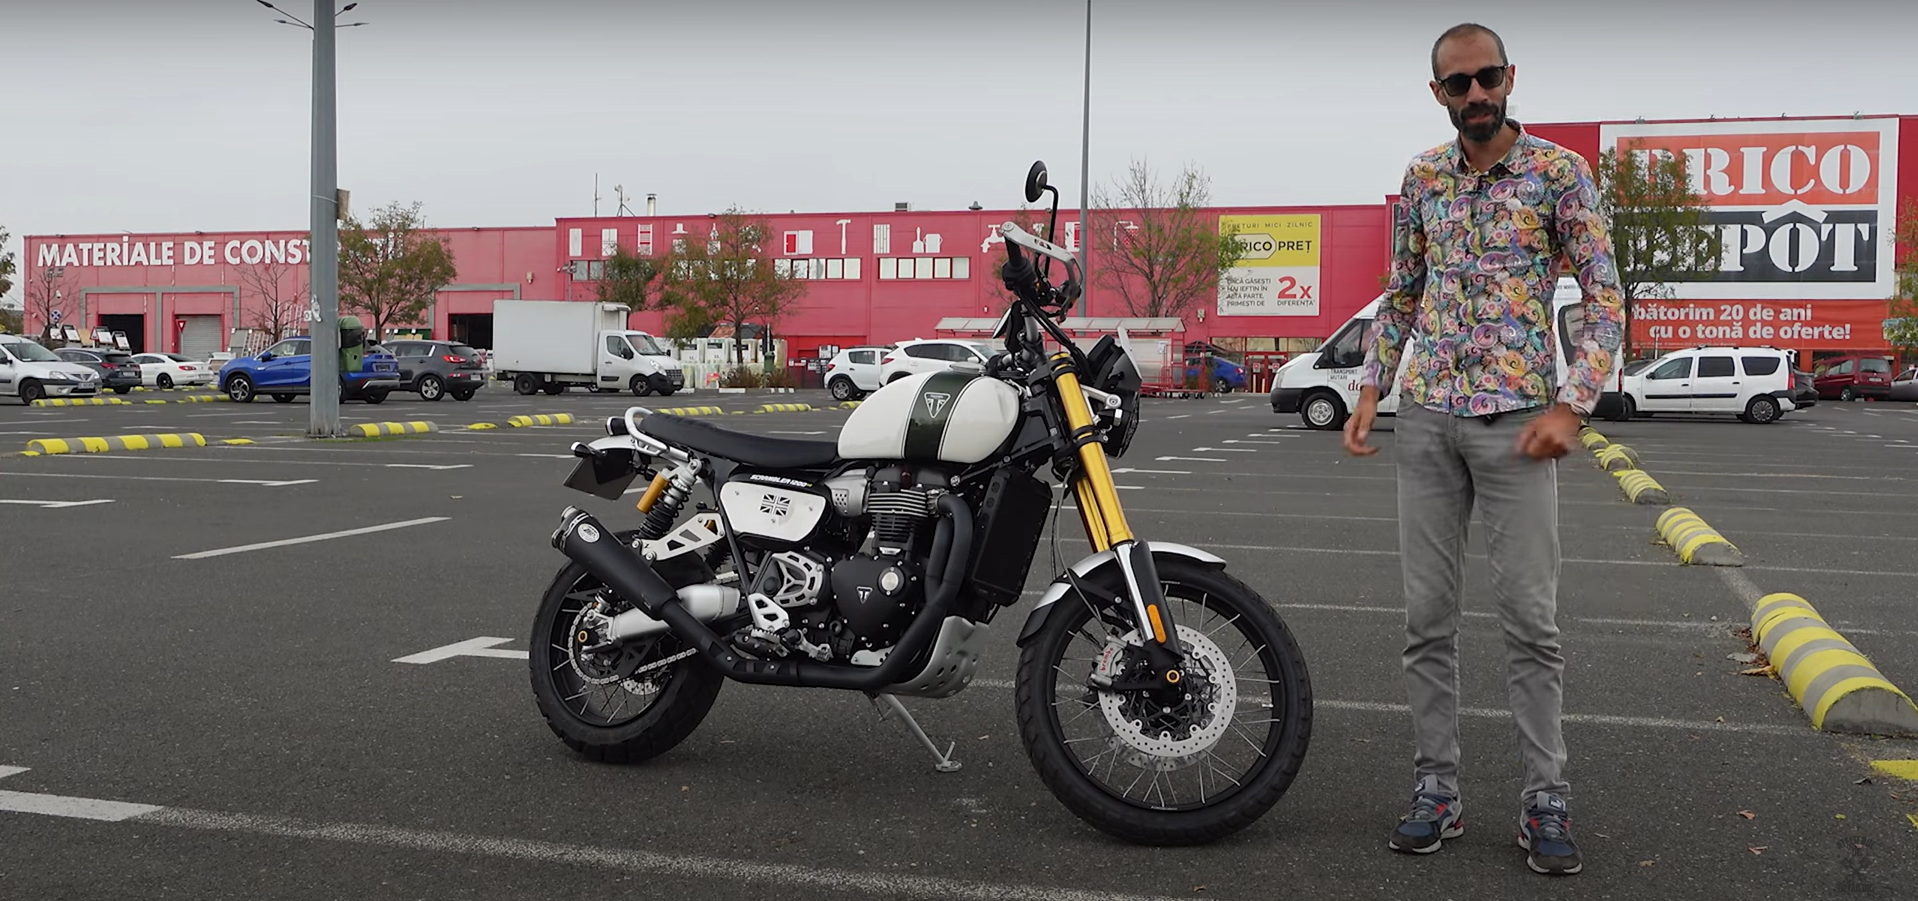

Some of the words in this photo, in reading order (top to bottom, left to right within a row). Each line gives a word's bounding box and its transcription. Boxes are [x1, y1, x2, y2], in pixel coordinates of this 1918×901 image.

[1631, 144, 1871, 196] BRICO
[183, 240, 215, 265] DE
[1239, 241, 1273, 252] RICO
[1277, 276, 1312, 299] 2x
[1631, 304, 1714, 321] bătorim
[1720, 305, 1744, 320] 20
[1749, 304, 1775, 320] de
[1779, 304, 1812, 320] ani
[1649, 325, 1673, 339] cu
[1678, 325, 1691, 339] o
[1696, 321, 1743, 339] tonă
[1748, 322, 1774, 339] de
[1779, 322, 1851, 340] oferte!
